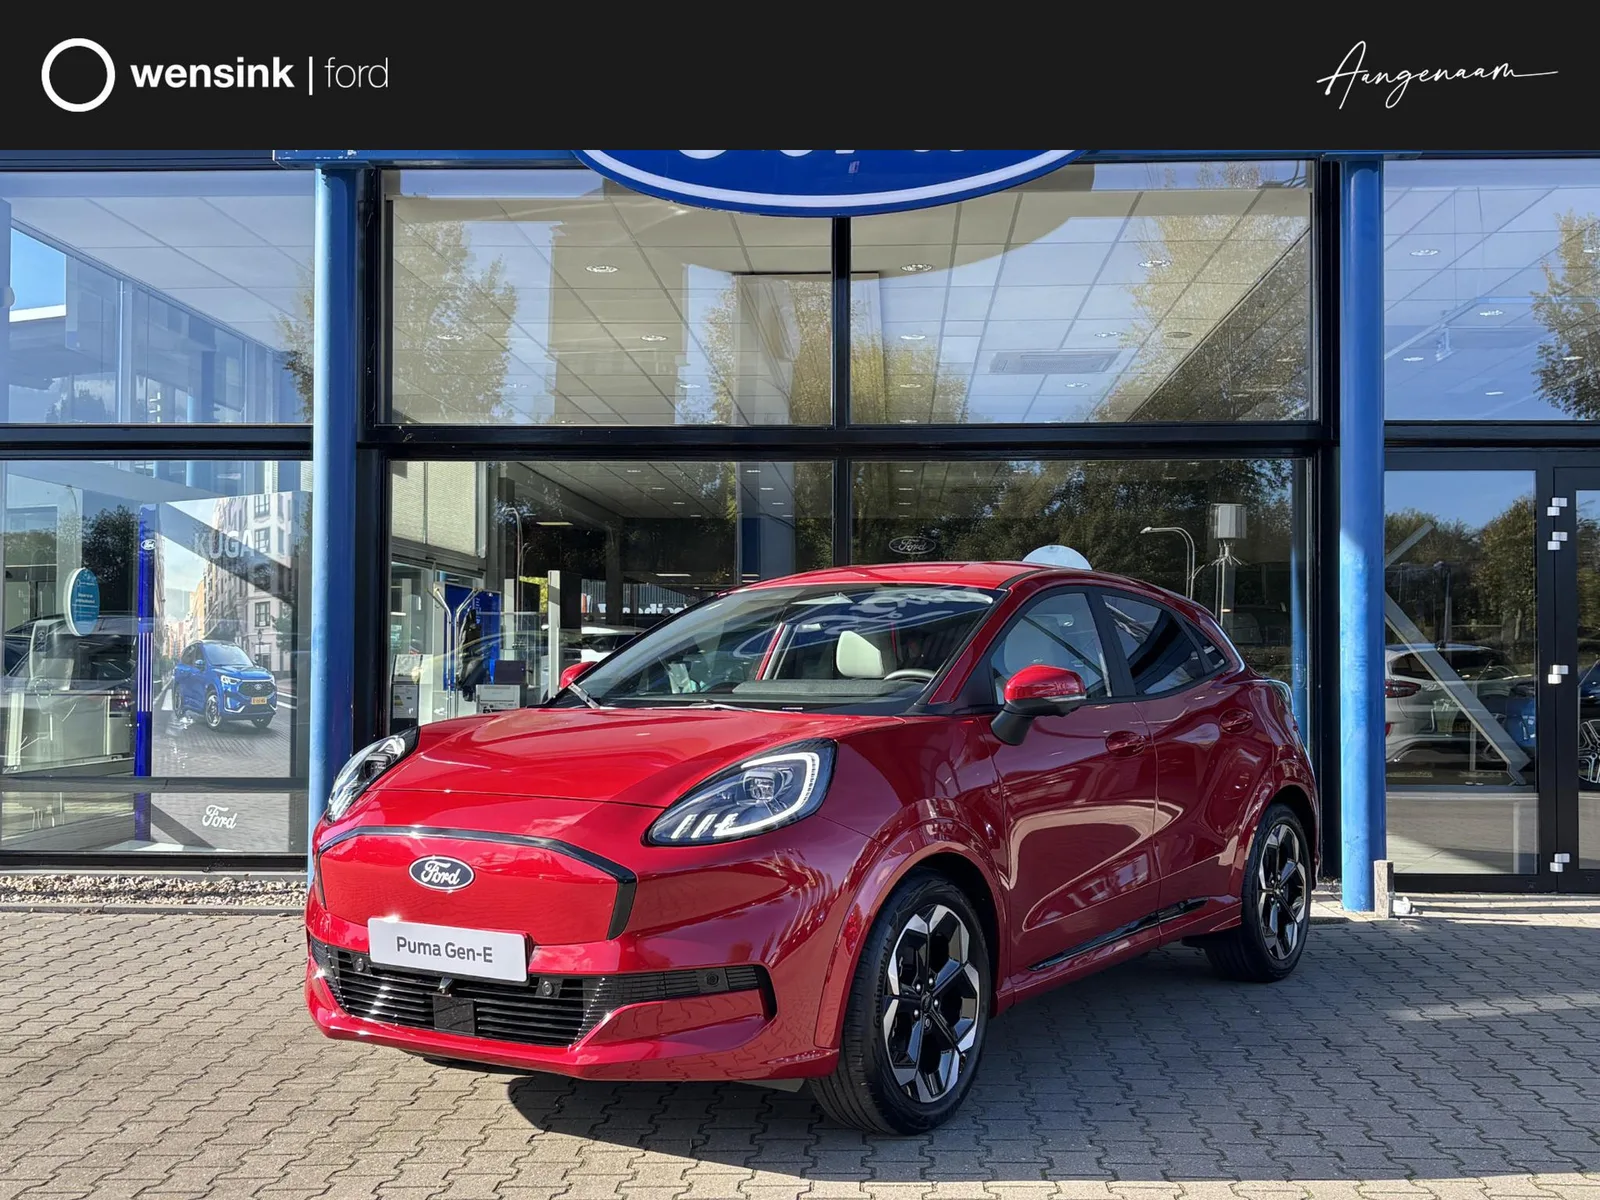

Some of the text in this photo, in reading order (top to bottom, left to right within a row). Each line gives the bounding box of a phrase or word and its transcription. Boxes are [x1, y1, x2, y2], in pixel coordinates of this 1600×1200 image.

[194, 530, 255, 559] KUGA
[202, 804, 237, 829] Ford
[421, 860, 461, 885] Ford
[396, 936, 493, 963] Puma Gen-E
